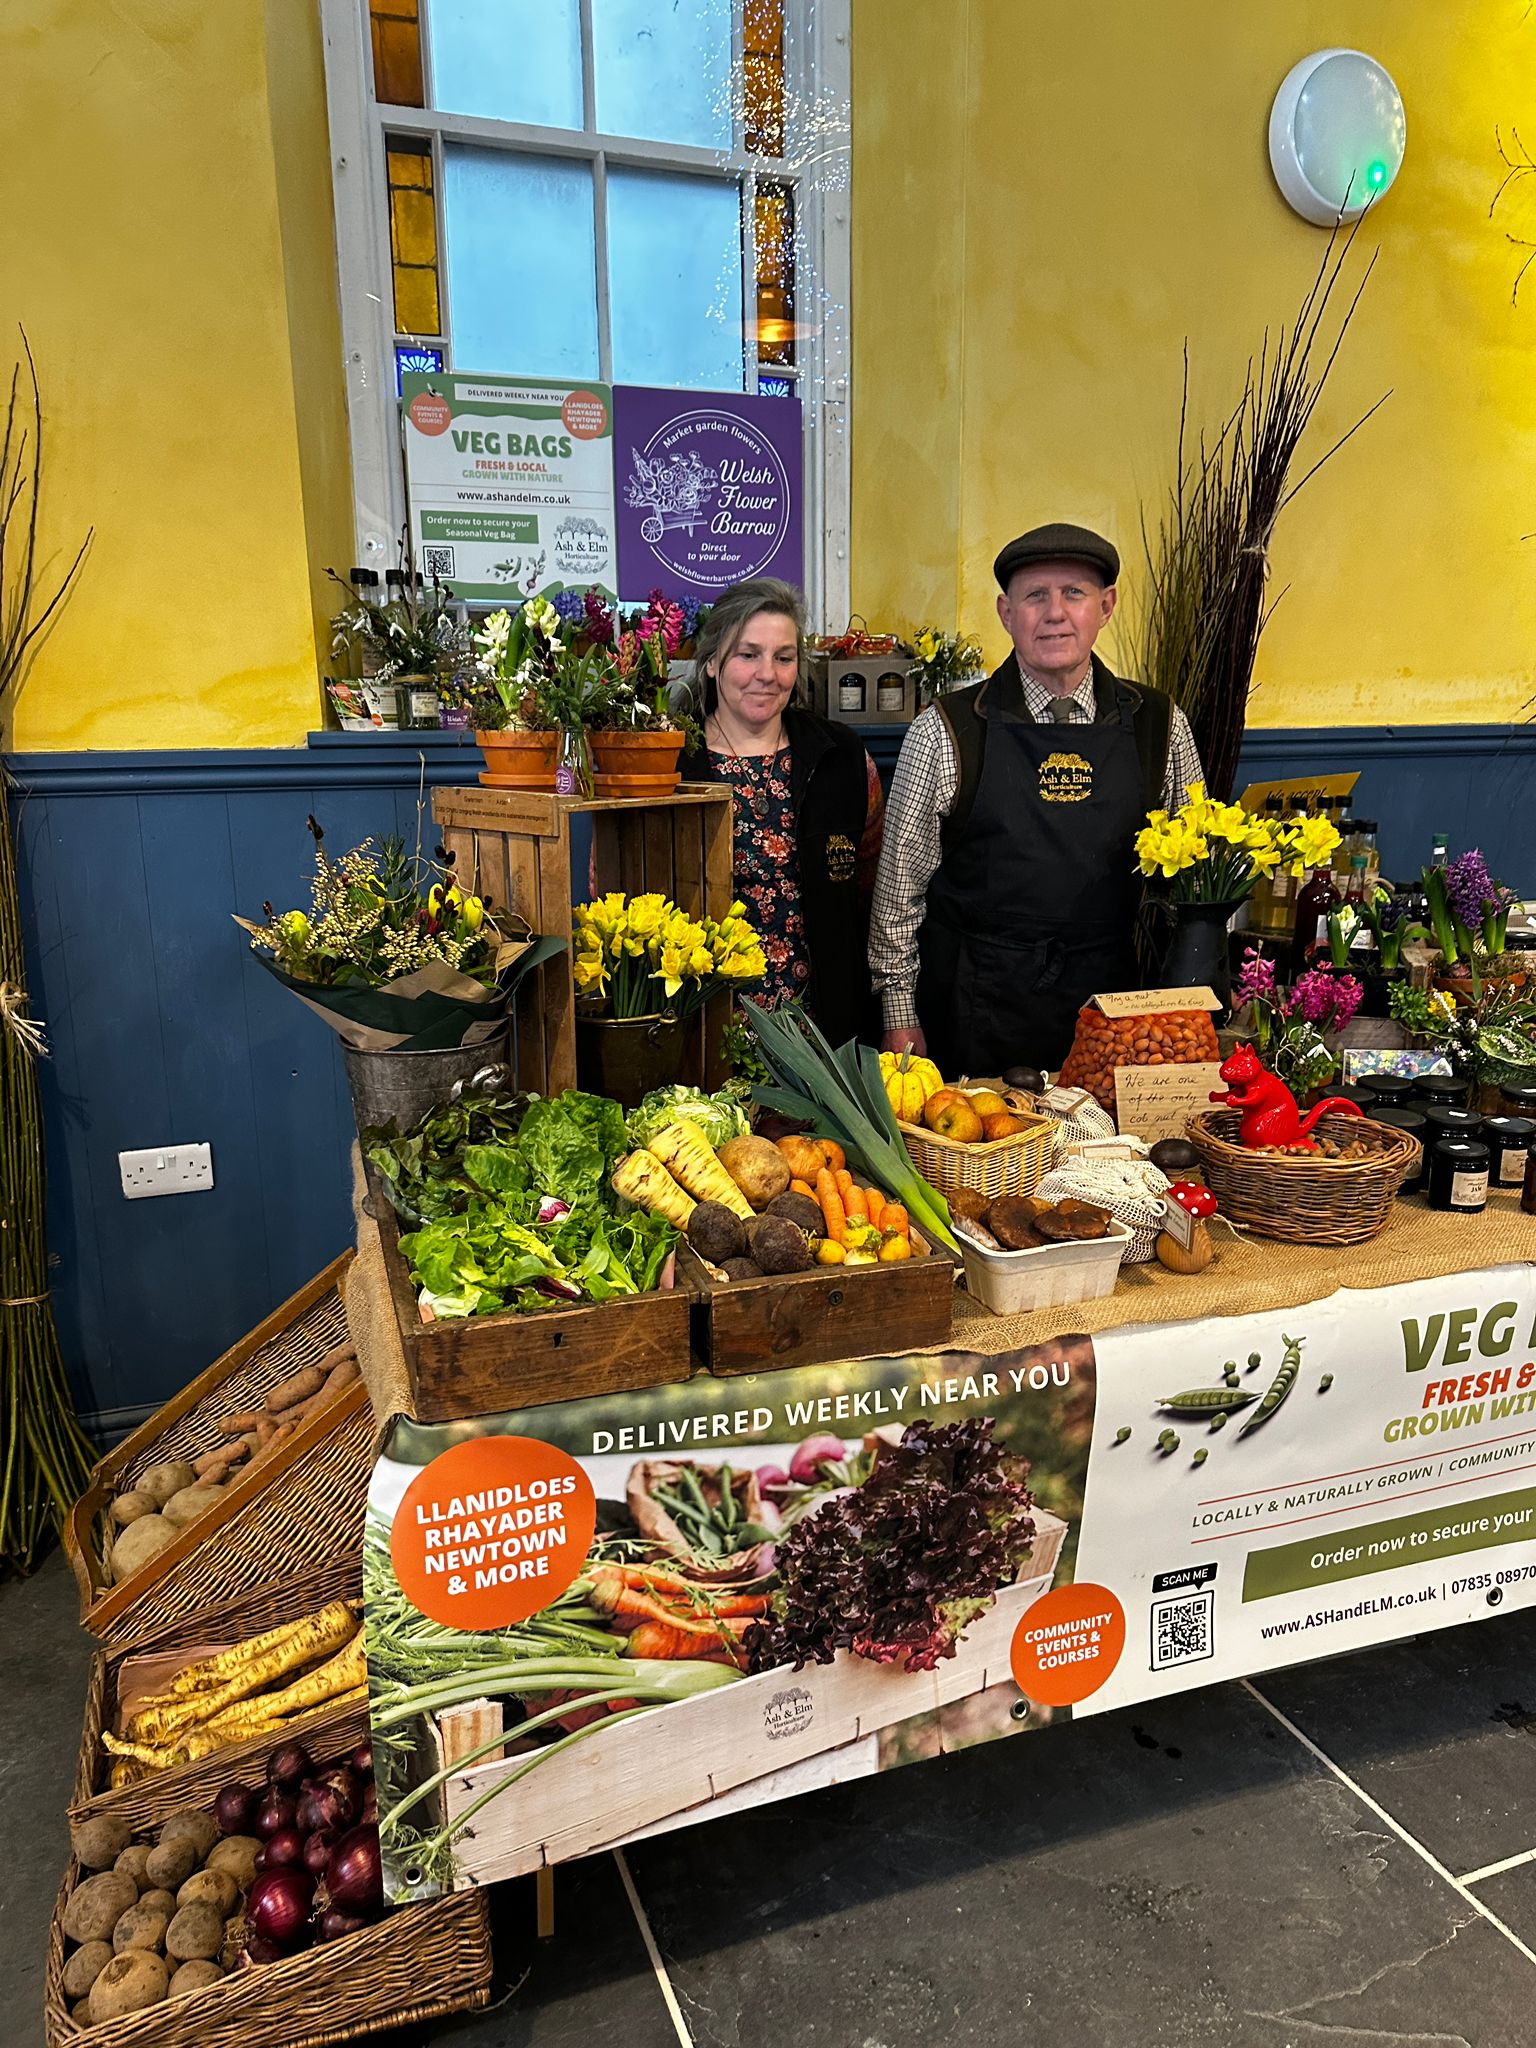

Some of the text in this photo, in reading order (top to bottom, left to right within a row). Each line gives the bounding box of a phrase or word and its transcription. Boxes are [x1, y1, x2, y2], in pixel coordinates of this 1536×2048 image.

[467, 389, 503, 398] DELIVERED
[504, 391, 529, 400] WEEKLY
[567, 416, 602, 424] NEWTOWN
[451, 430, 573, 458] VEG BAGS
[662, 421, 762, 456] Market garden flowers
[462, 469, 564, 483] GROWN WITH NATURE
[475, 460, 548, 472] FRESH & LOCAL
[719, 459, 775, 485] Welsh
[457, 491, 571, 505] www.ashandelm.co.uk
[718, 485, 777, 510] Flower
[426, 516, 531, 529] Order now to secure your
[445, 528, 516, 540] Seasonal Veg Bag
[710, 511, 776, 536] Barrow
[554, 540, 608, 553] Ash & Elm
[687, 552, 741, 562] to your door
[701, 542, 728, 552] Direct
[673, 561, 755, 583] welshflowerbarrow.co.uk
[1039, 773, 1092, 785] Ash & Elm
[1125, 1073, 1144, 1088] We
[1153, 1077, 1172, 1086] are
[1128, 1092, 1198, 1111] of the only
[1155, 1111, 1177, 1123] nut
[1401, 1301, 1518, 1373] VEG
[1422, 1362, 1536, 1409] FRESH &
[592, 1361, 1071, 1454] DELIVERED WEEKLY NEAR YOU
[1383, 1401, 1485, 1443] GROWN
[1192, 1502, 1264, 1528] LOCALLY
[1267, 1500, 1279, 1512] &
[1284, 1479, 1374, 1510] NATURALLY
[1377, 1465, 1433, 1488] GROWN
[1449, 1441, 1535, 1471] COMMUNITY
[416, 1475, 576, 1525] LLANIDLOES
[425, 1501, 564, 1549] RHAYADER
[424, 1525, 567, 1575] NEWTOWN
[1310, 1508, 1534, 1569] Order now to secure your
[447, 1556, 549, 1596] & MORE
[1161, 1568, 1209, 1587] SCAN ME
[1261, 1585, 1437, 1639] www.ASHandELM.co.uk
[1451, 1573, 1492, 1595] 07835
[1496, 1565, 1536, 1585] 08970
[1024, 1612, 1113, 1643] COMMUNITY
[1036, 1630, 1101, 1656] EVENTS &
[1038, 1645, 1100, 1671] COURSES
[764, 1703, 813, 1727] Ash & Elm
